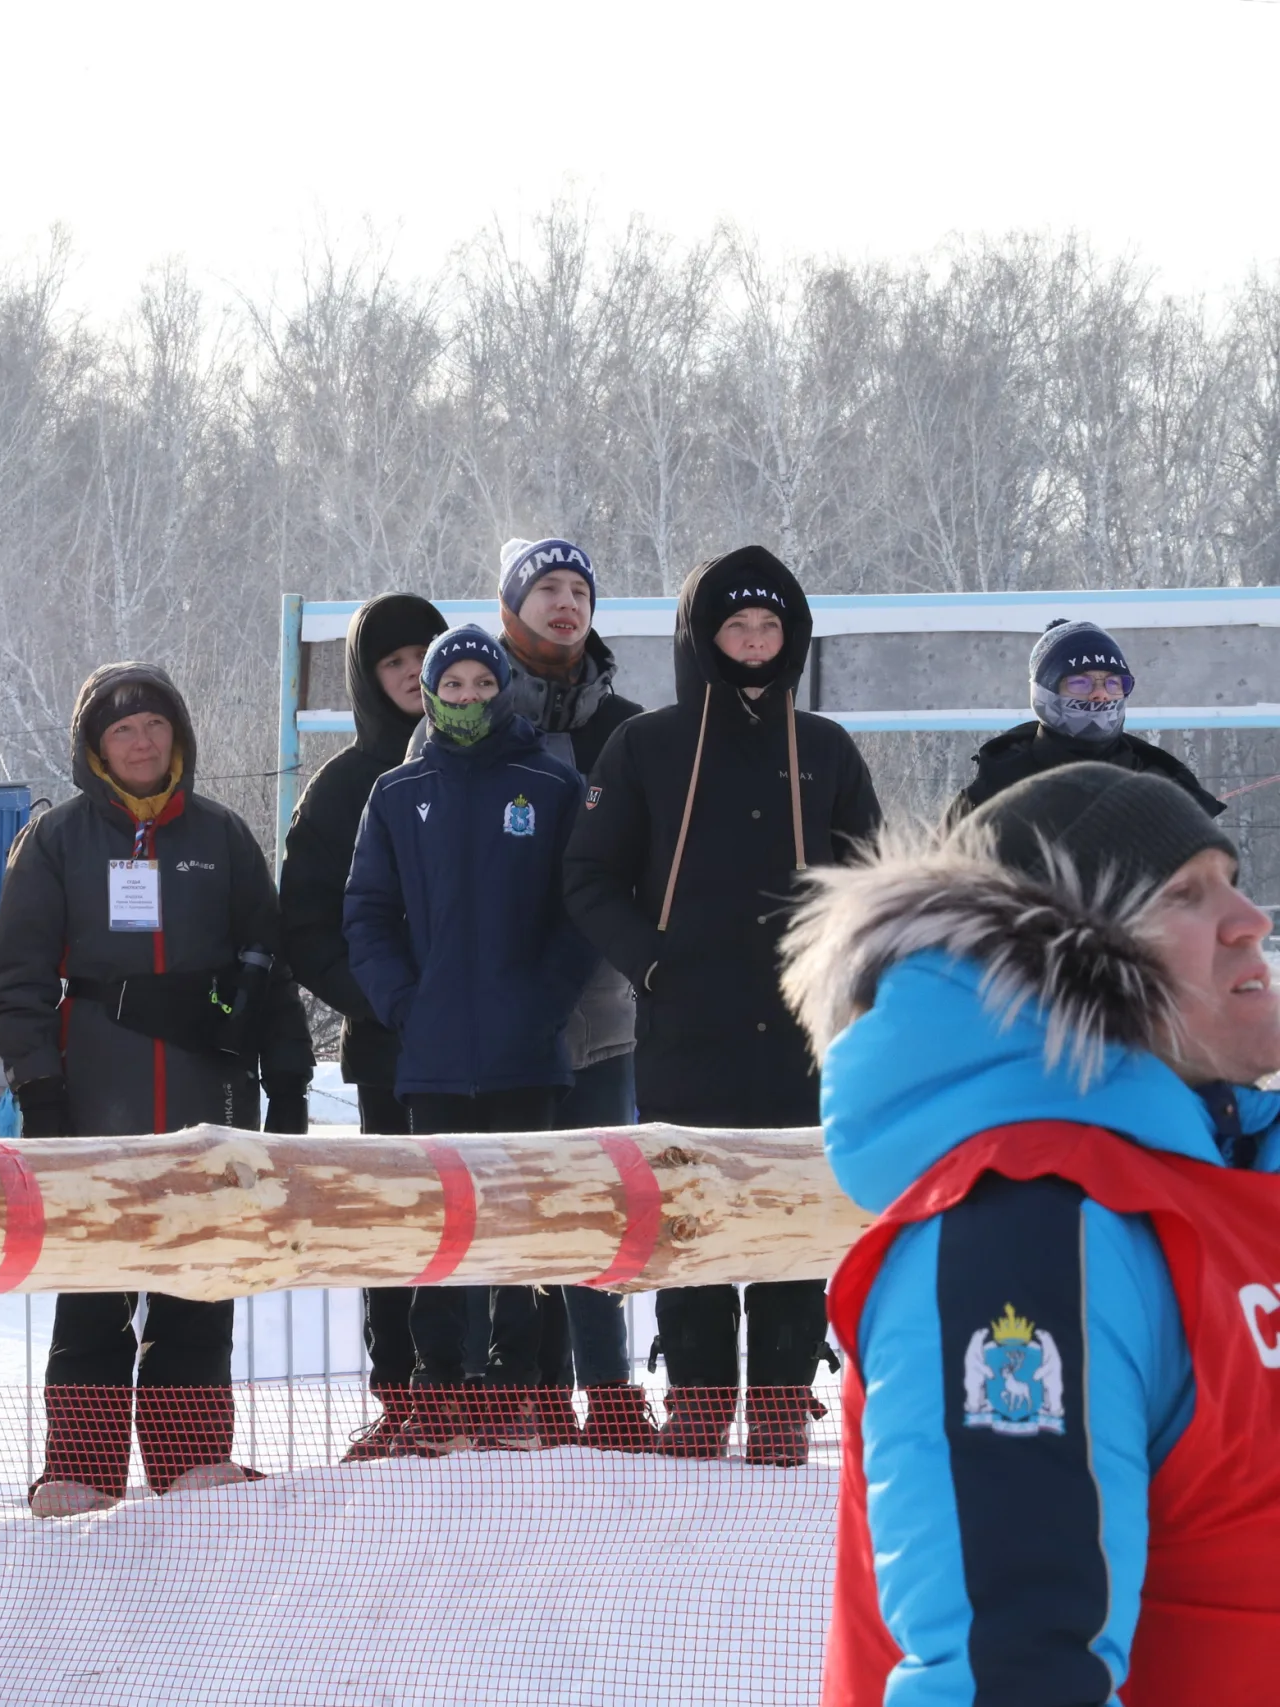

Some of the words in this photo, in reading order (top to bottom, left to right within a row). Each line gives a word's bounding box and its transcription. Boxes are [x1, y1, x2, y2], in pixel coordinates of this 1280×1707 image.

[728, 588, 786, 608] YAMAL
[440, 641, 499, 660] YAMAL
[1068, 654, 1127, 669] YAMAL
[1238, 1283, 1280, 1368] С
